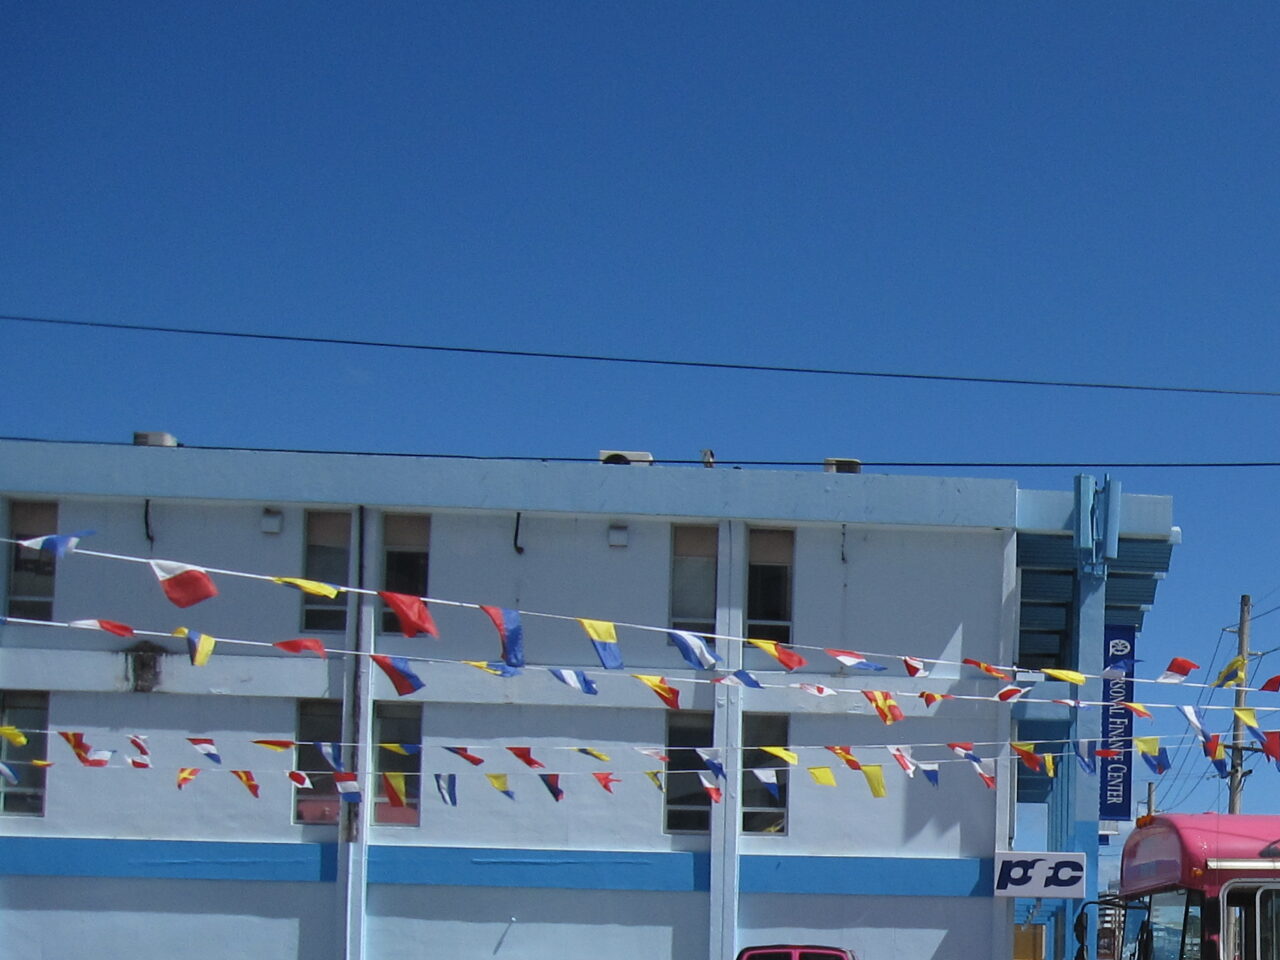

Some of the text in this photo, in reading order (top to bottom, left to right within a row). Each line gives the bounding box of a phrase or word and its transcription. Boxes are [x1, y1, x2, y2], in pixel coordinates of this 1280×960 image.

[1106, 662, 1128, 805] RSONAL FINANE CENTER
[996, 858, 1084, 890] pfc
